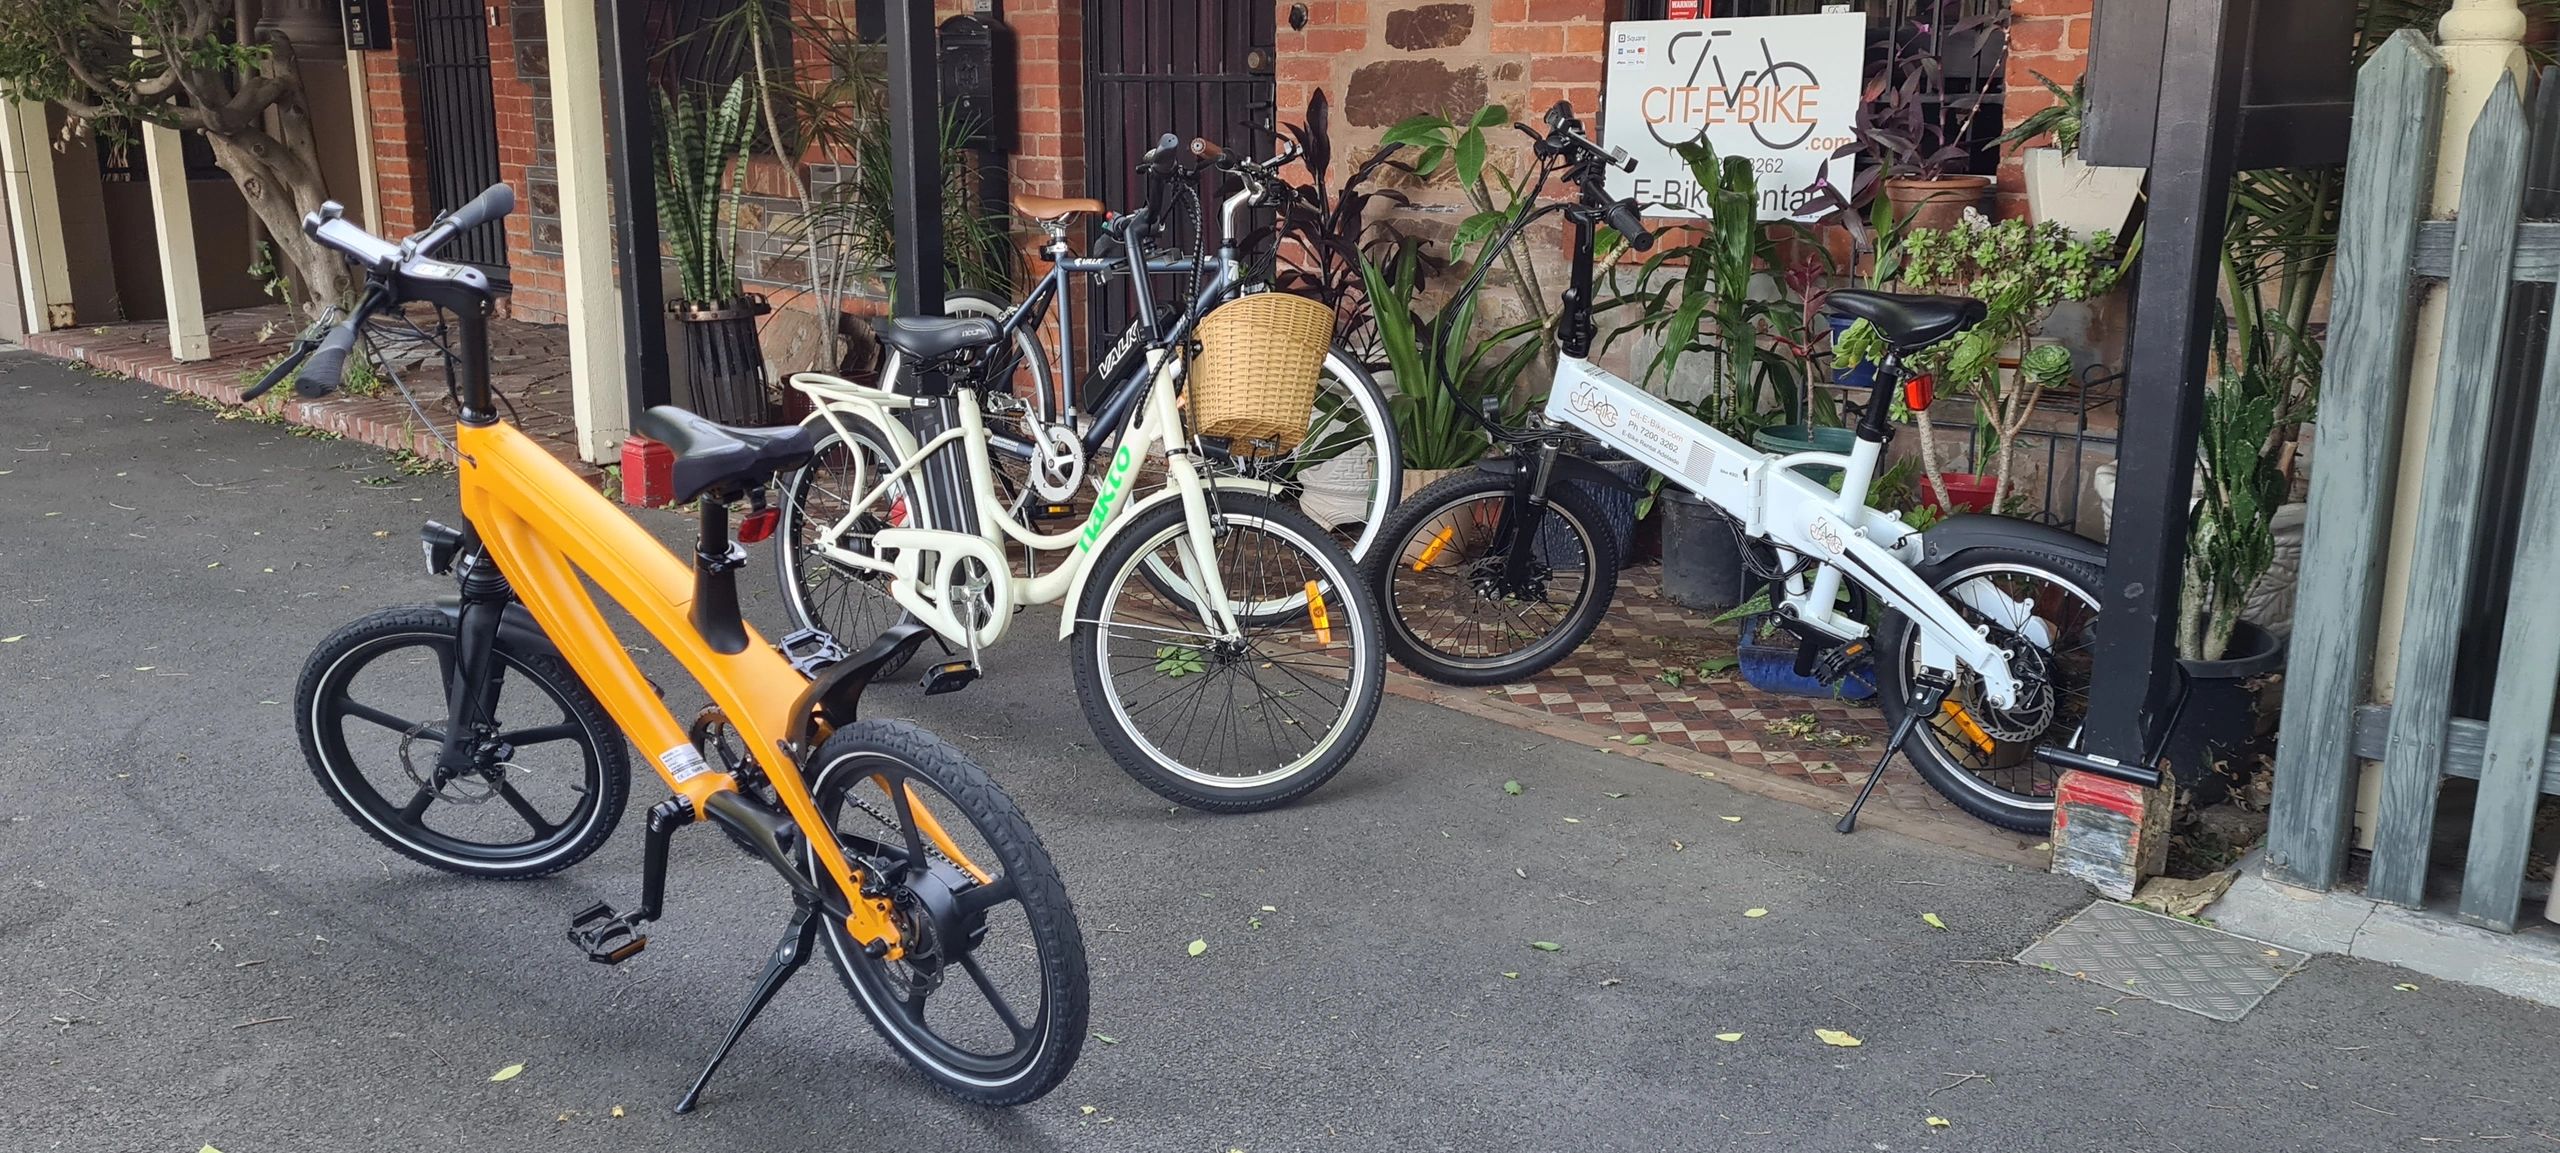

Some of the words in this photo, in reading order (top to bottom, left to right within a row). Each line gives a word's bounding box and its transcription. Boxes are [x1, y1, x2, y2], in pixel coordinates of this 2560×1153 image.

[1626, 34, 1646, 42] Square
[1641, 85, 1820, 124] CIT-E-BIKE
[1633, 178, 1706, 208] E-Bik
[1098, 319, 1139, 380] VALK
[1628, 420, 1638, 431] Ph
[1640, 426, 1659, 442] 7200
[1659, 437, 1679, 453] 3262
[1077, 444, 1132, 555] nakto
